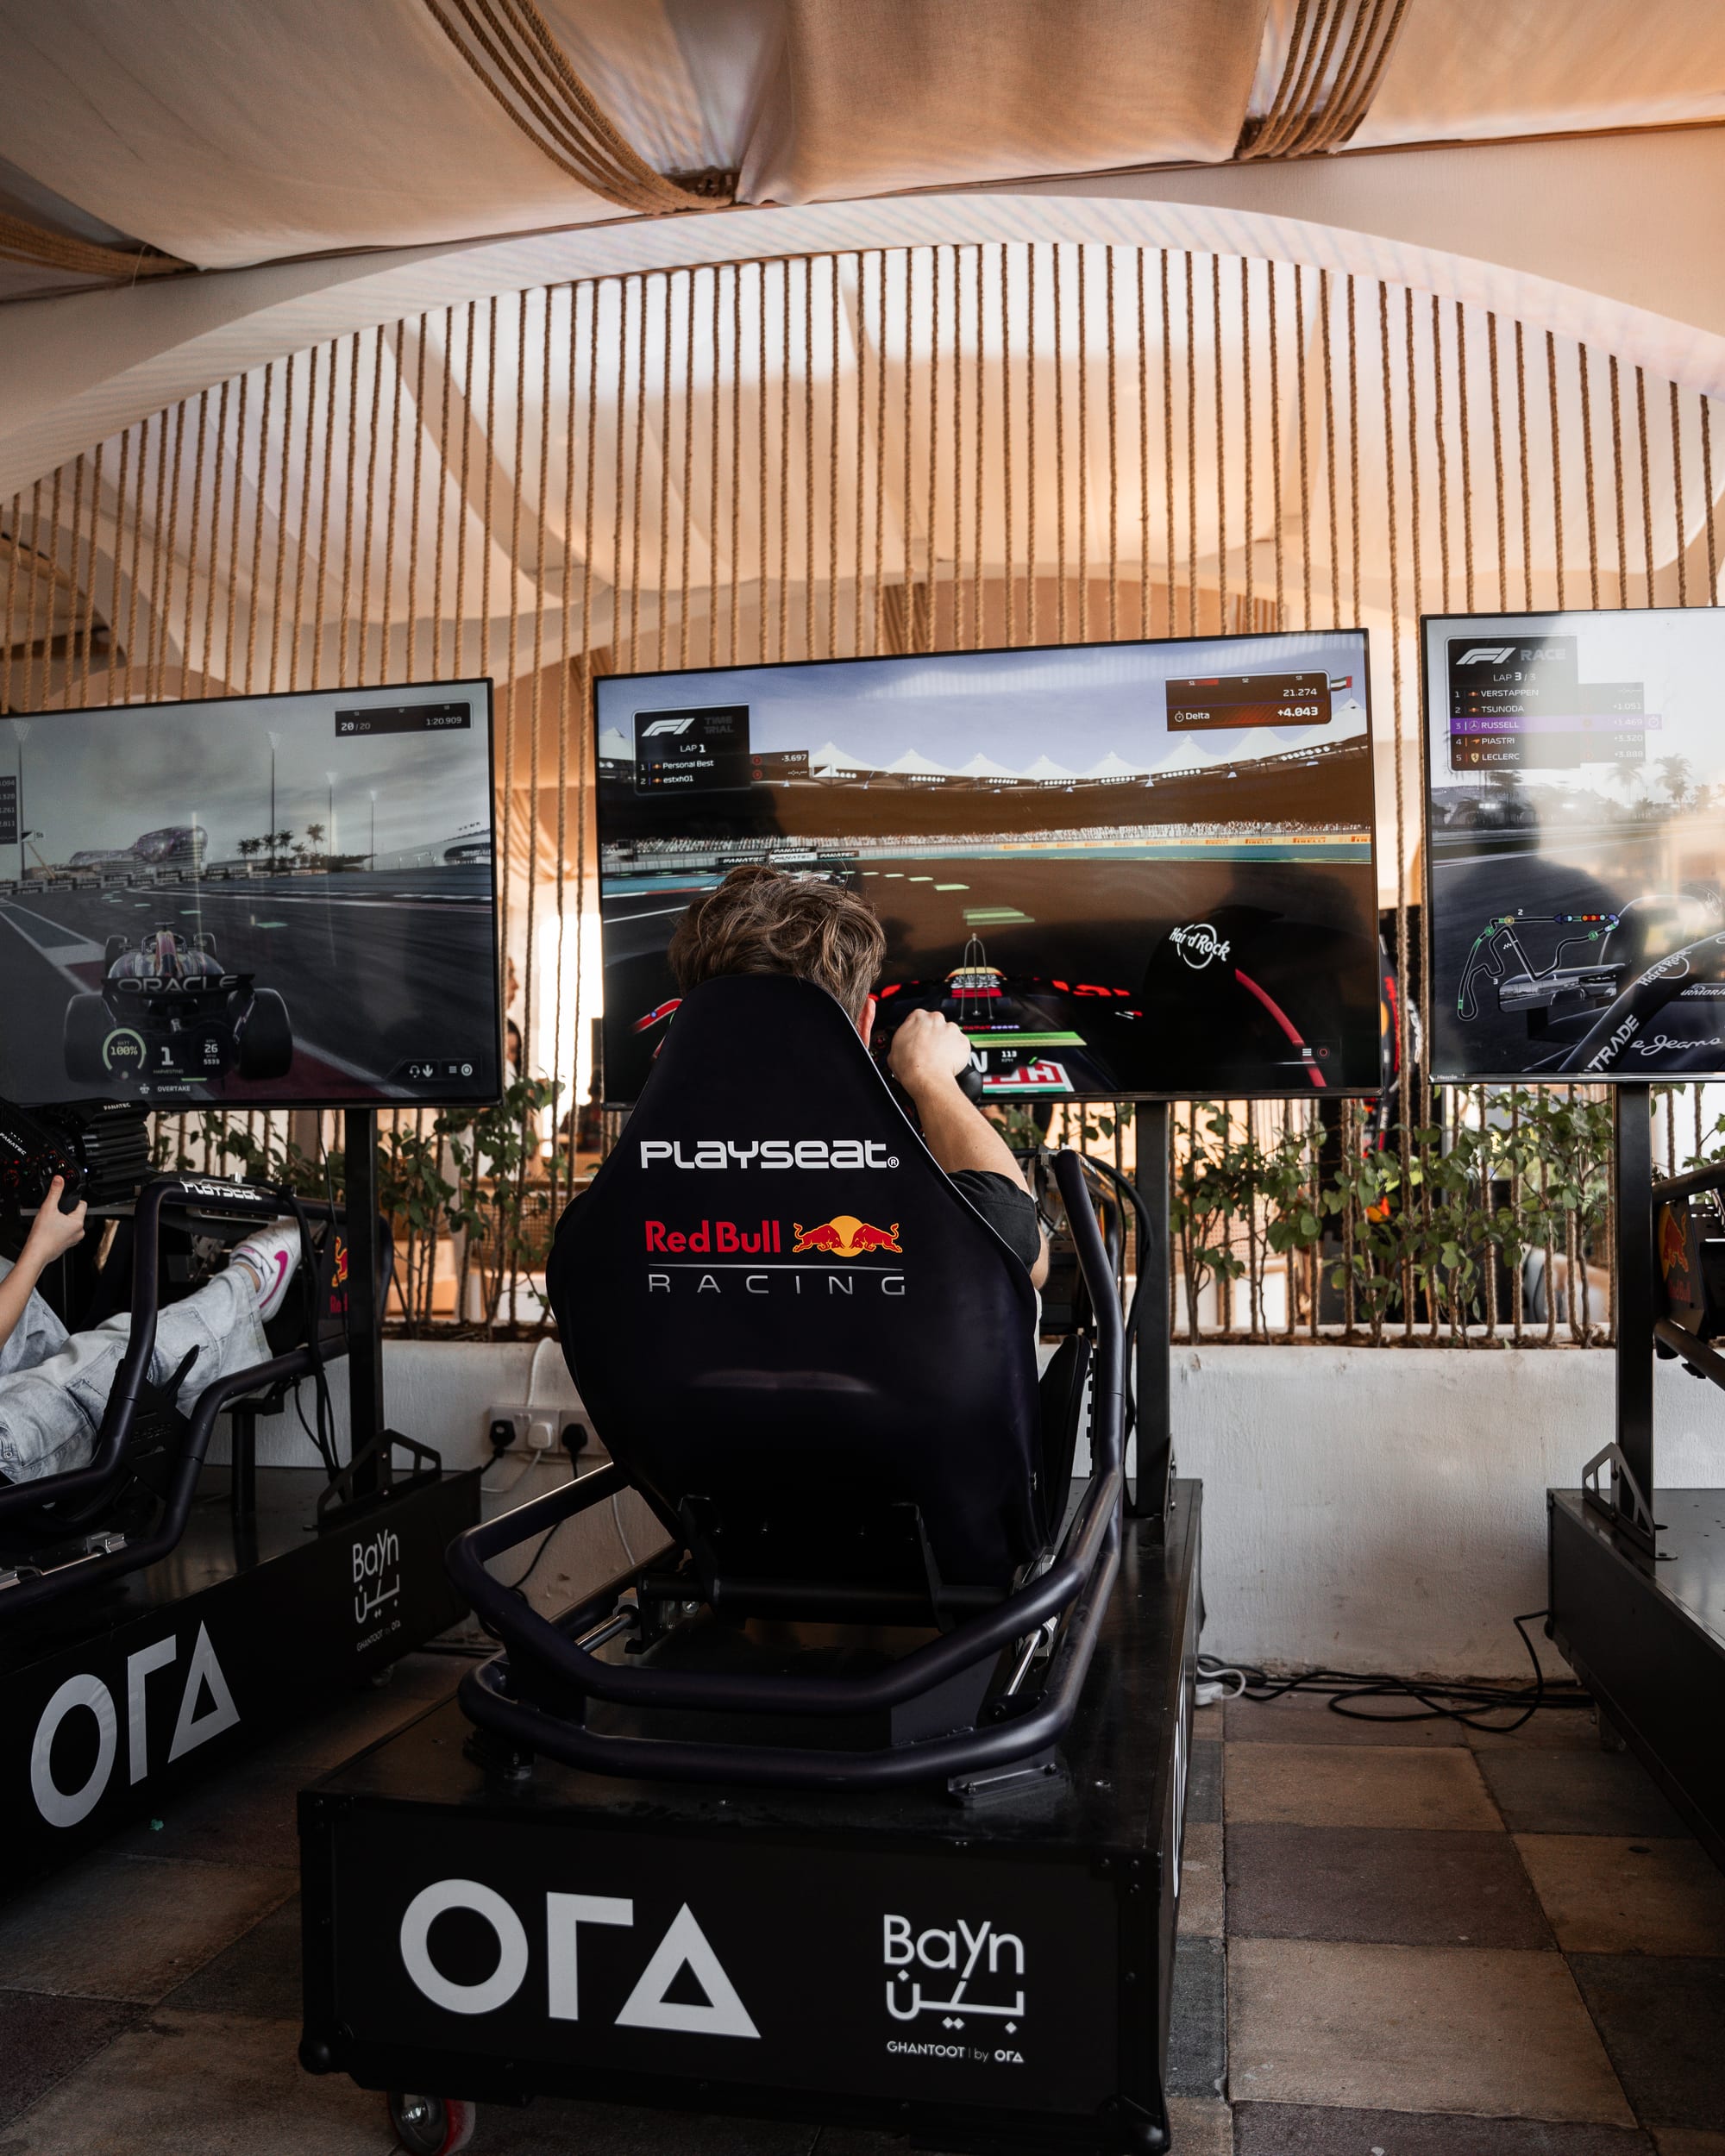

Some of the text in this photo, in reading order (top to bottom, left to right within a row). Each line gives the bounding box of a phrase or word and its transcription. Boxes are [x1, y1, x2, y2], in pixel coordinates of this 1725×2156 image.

[1521, 649, 1566, 661] RACE
[1493, 674, 1512, 682] LAP
[1515, 672, 1522, 681] 3
[1283, 688, 1318, 698] 21.274
[1481, 689, 1540, 698] VERSTAPPEN
[1186, 706, 1320, 721] Delta +4.043
[1481, 705, 1525, 714] TSUNODA
[1481, 721, 1520, 730] RUSSELL
[680, 743, 706, 753] LAP 1
[662, 761, 696, 770] Personal
[697, 760, 714, 768] Best
[1169, 926, 1231, 962] Hard Rock
[1637, 962, 1668, 986] Hard
[117, 975, 239, 992] ORACLE
[204, 1044, 218, 1053] 26
[1584, 1014, 1640, 1072] TRADE
[1640, 1035, 1723, 1056] Jeans
[110, 1045, 138, 1056] 100%
[161, 1046, 174, 1066] 1
[104, 1102, 131, 1111] FANATEC
[645, 1219, 781, 1253] Red Bull
[648, 1274, 906, 1295] RACING
[887, 2040, 965, 2059] GHANTOOT
[974, 2048, 989, 2062] by
